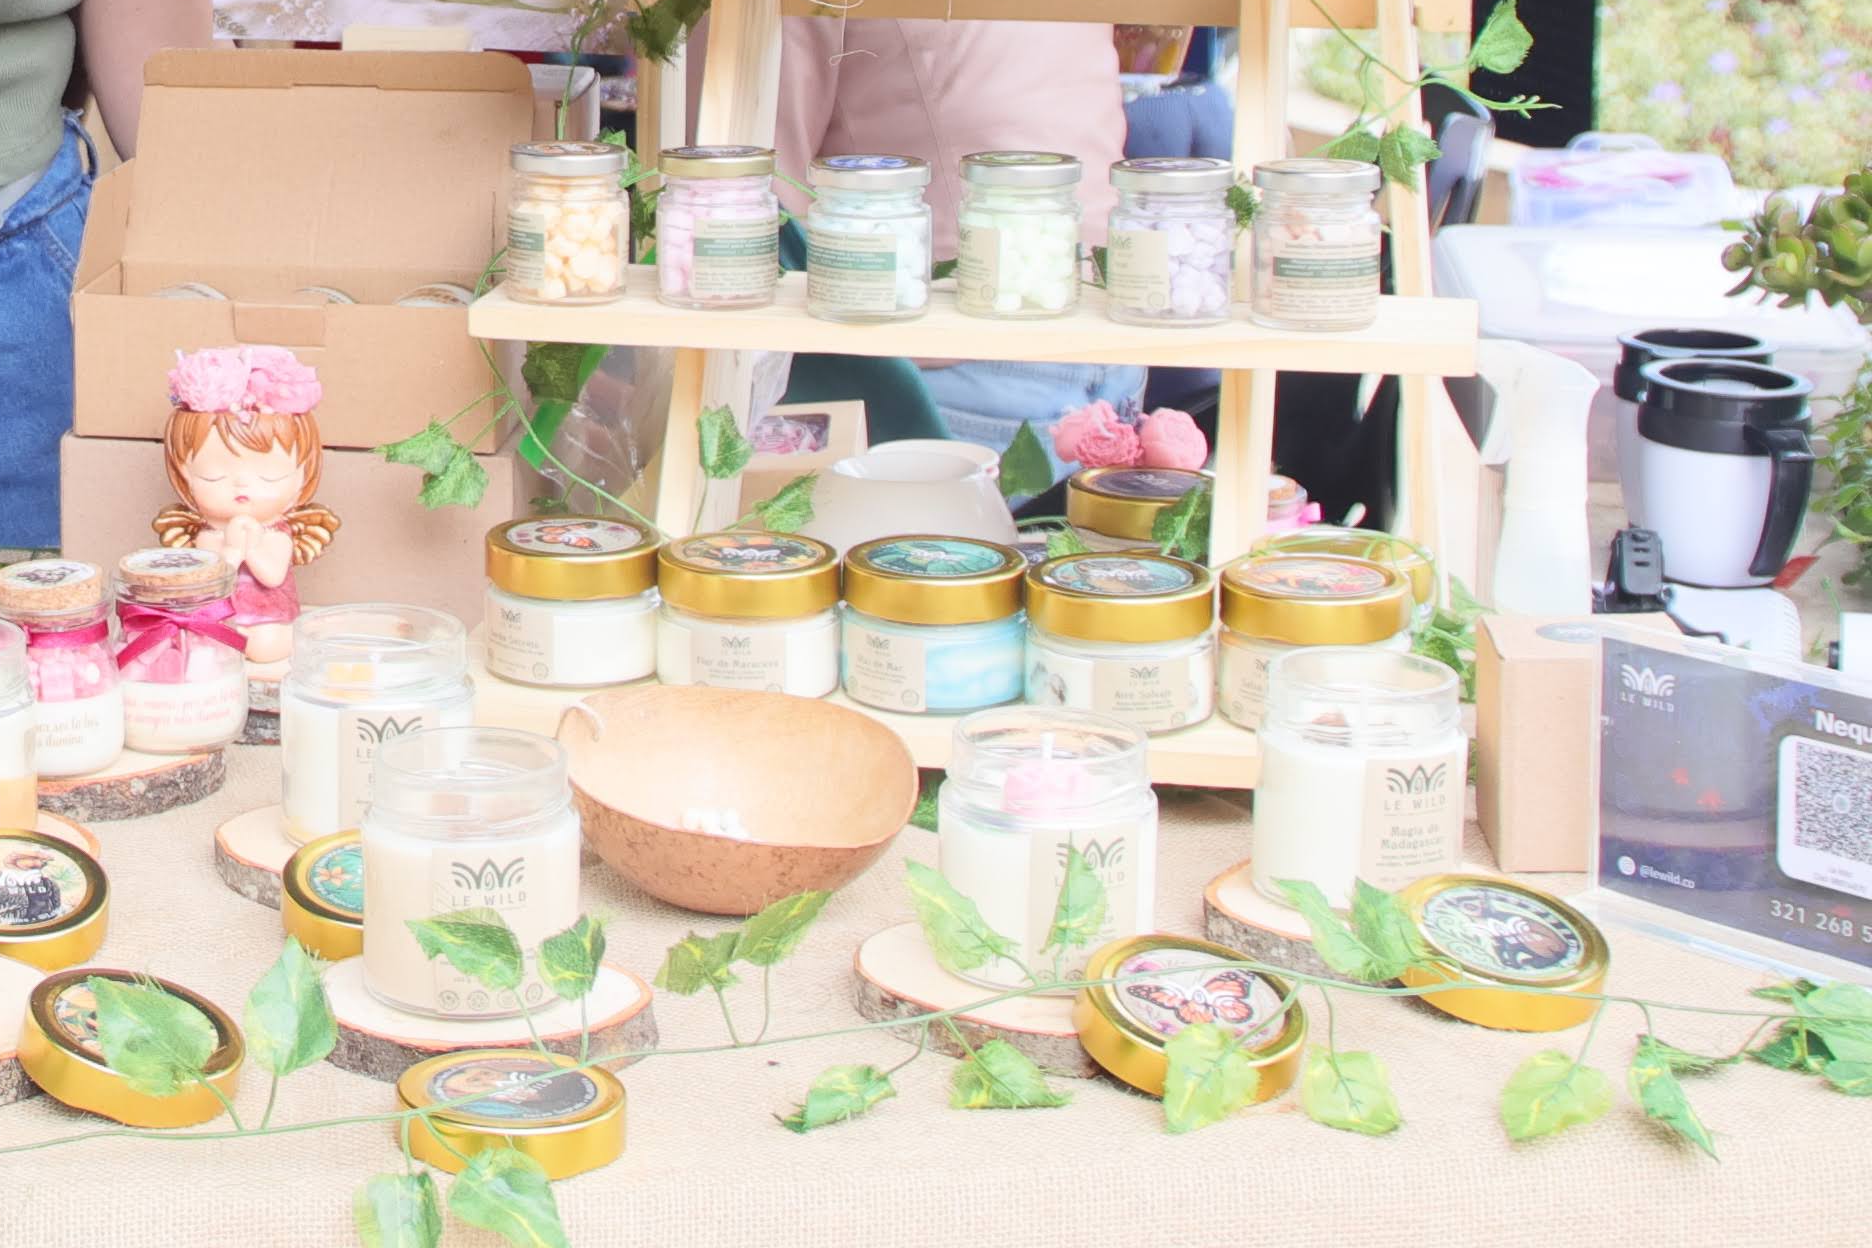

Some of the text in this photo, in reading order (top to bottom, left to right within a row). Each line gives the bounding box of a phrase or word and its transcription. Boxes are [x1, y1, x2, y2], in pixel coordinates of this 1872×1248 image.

[1621, 691, 1675, 713] LE WILD
[1383, 793, 1446, 811] LE WILD
[1639, 864, 1696, 889] @lewild.co
[8, 886, 47, 896] WILD
[451, 891, 527, 907] LE WILD
[1770, 900, 1806, 924] 321
[1816, 913, 1854, 938] 268
